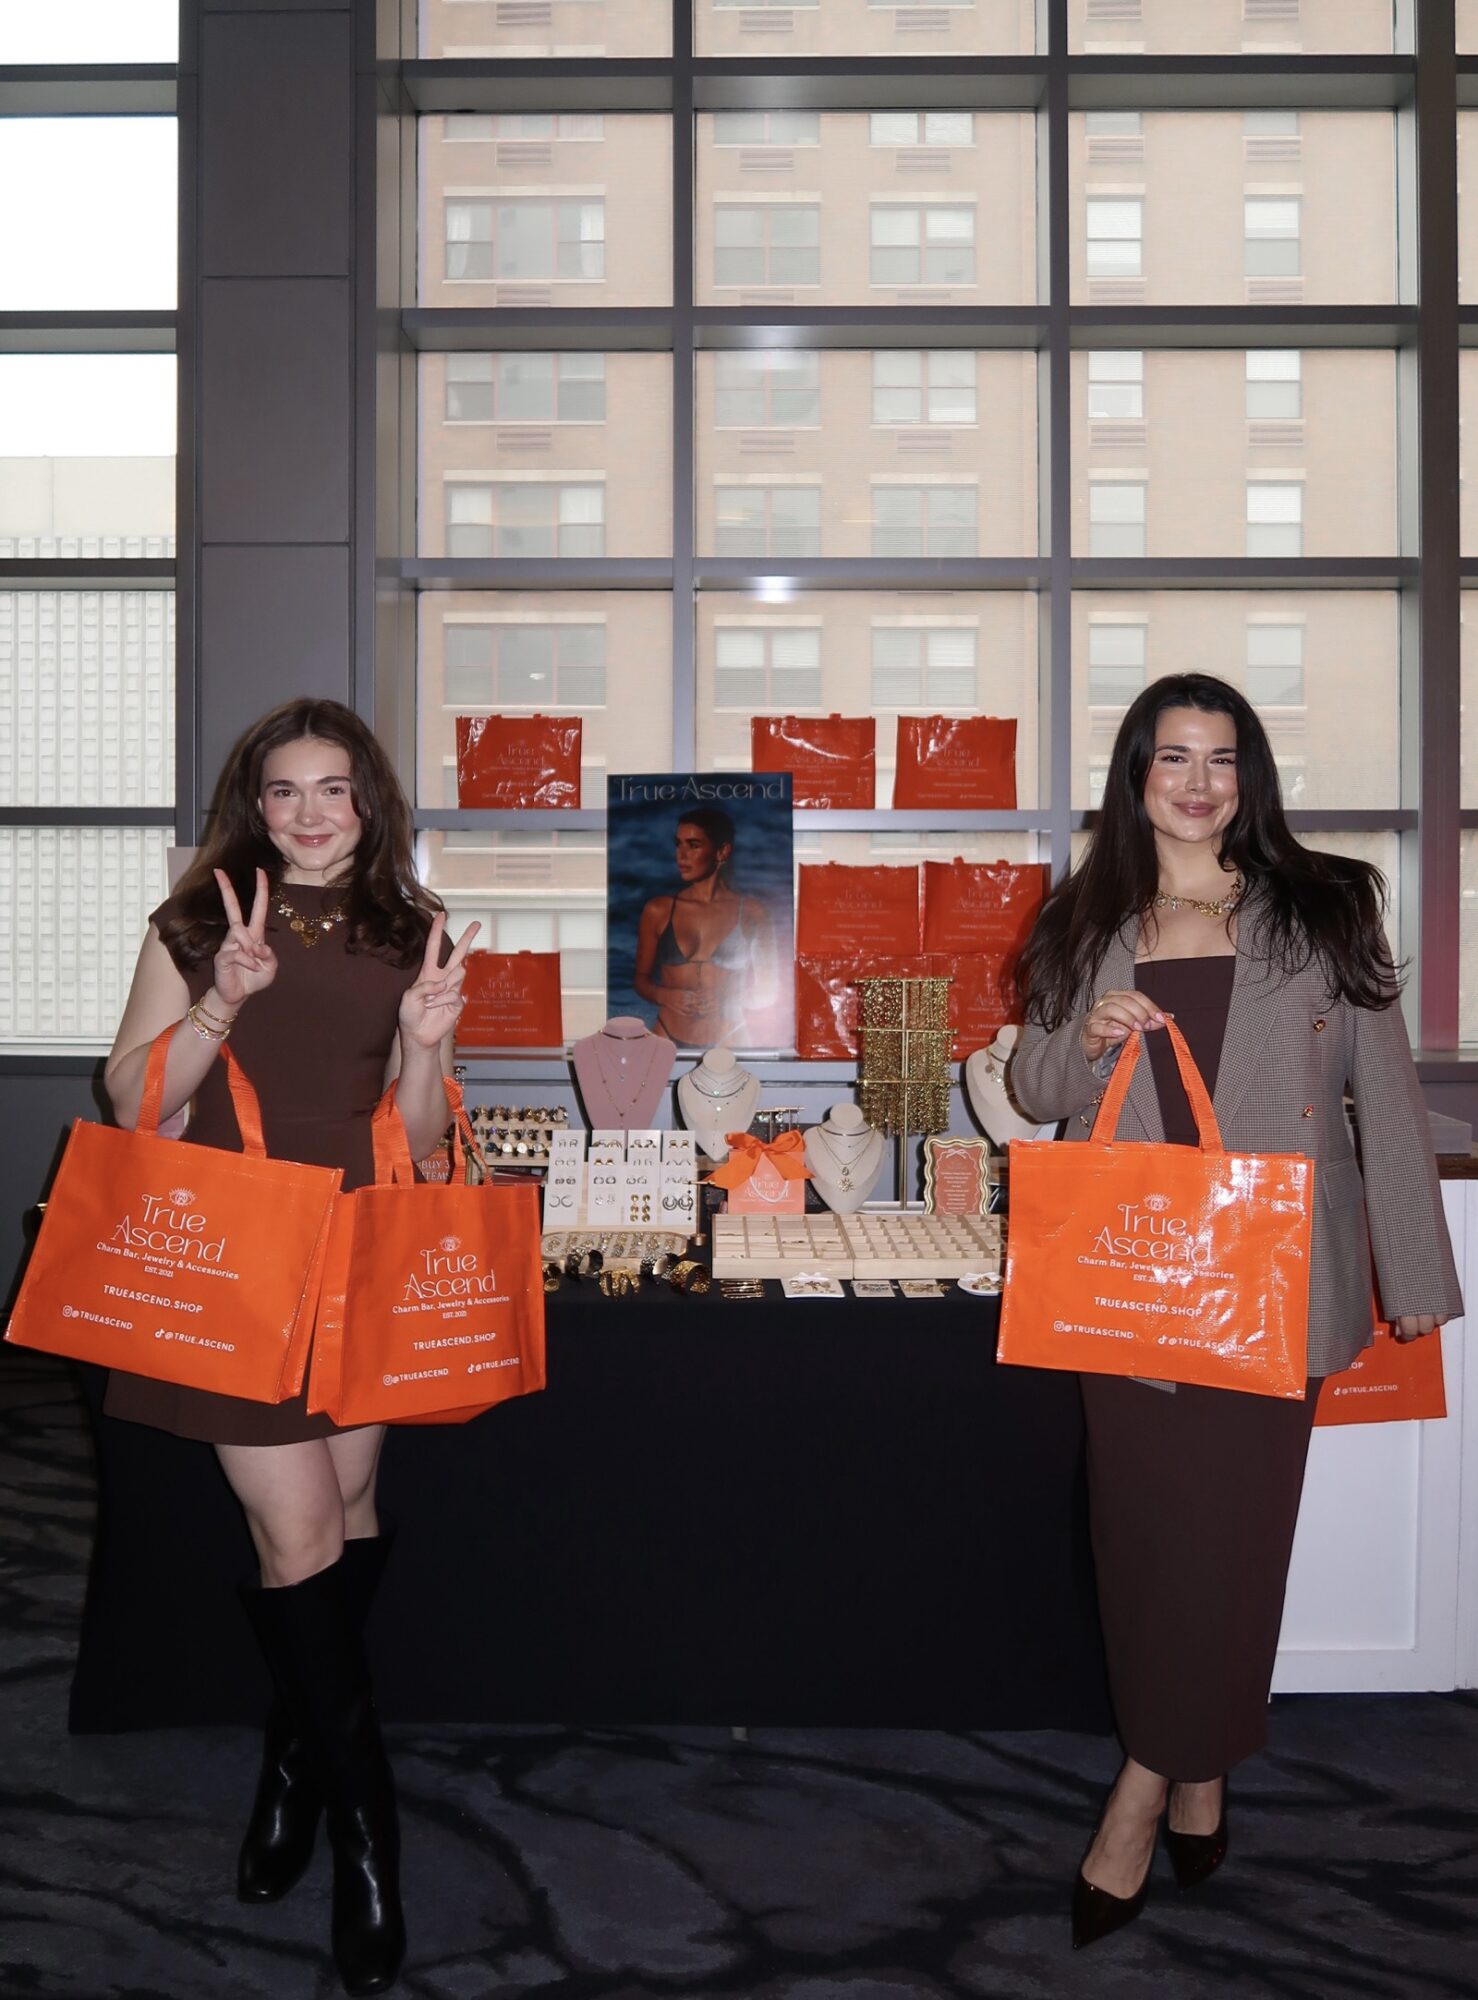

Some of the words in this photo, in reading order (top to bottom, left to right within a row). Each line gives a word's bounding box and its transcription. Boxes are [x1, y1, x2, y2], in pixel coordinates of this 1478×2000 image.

[614, 777, 676, 801] True
[681, 776, 784, 800] Ascend
[421, 1160, 441, 1169] BUY
[141, 1193, 207, 1233] True
[1117, 1203, 1187, 1236] True
[110, 1215, 226, 1263] Ascend
[1091, 1226, 1213, 1265] Ascend
[96, 1241, 121, 1255] Charm
[142, 1252, 176, 1268] Jewelry
[177, 1259, 184, 1268] &
[185, 1262, 239, 1280] Accessories
[420, 1249, 477, 1276] True
[1077, 1255, 1107, 1267] Charm
[1109, 1259, 1128, 1270] Bar,
[402, 1268, 496, 1301] Ascend
[103, 1284, 203, 1314] TRUEASCEND.SHOP
[392, 1304, 420, 1314] Charm
[437, 1299, 465, 1309] Jewelry
[467, 1298, 473, 1306] &
[474, 1294, 511, 1305] Accessories
[1094, 1296, 1203, 1317] TRUEASCEND.SHOP
[72, 1310, 133, 1330] @TRUEASCEND
[164, 1331, 235, 1352] @TRUE.ASCEND
[413, 1332, 496, 1351] TRUEASCEND.SHOP
[1064, 1323, 1134, 1339] @TRUEASCEND
[392, 1368, 449, 1384] @TRUEASCEND
[1341, 1384, 1398, 1395] @TRUE.ASCEND
